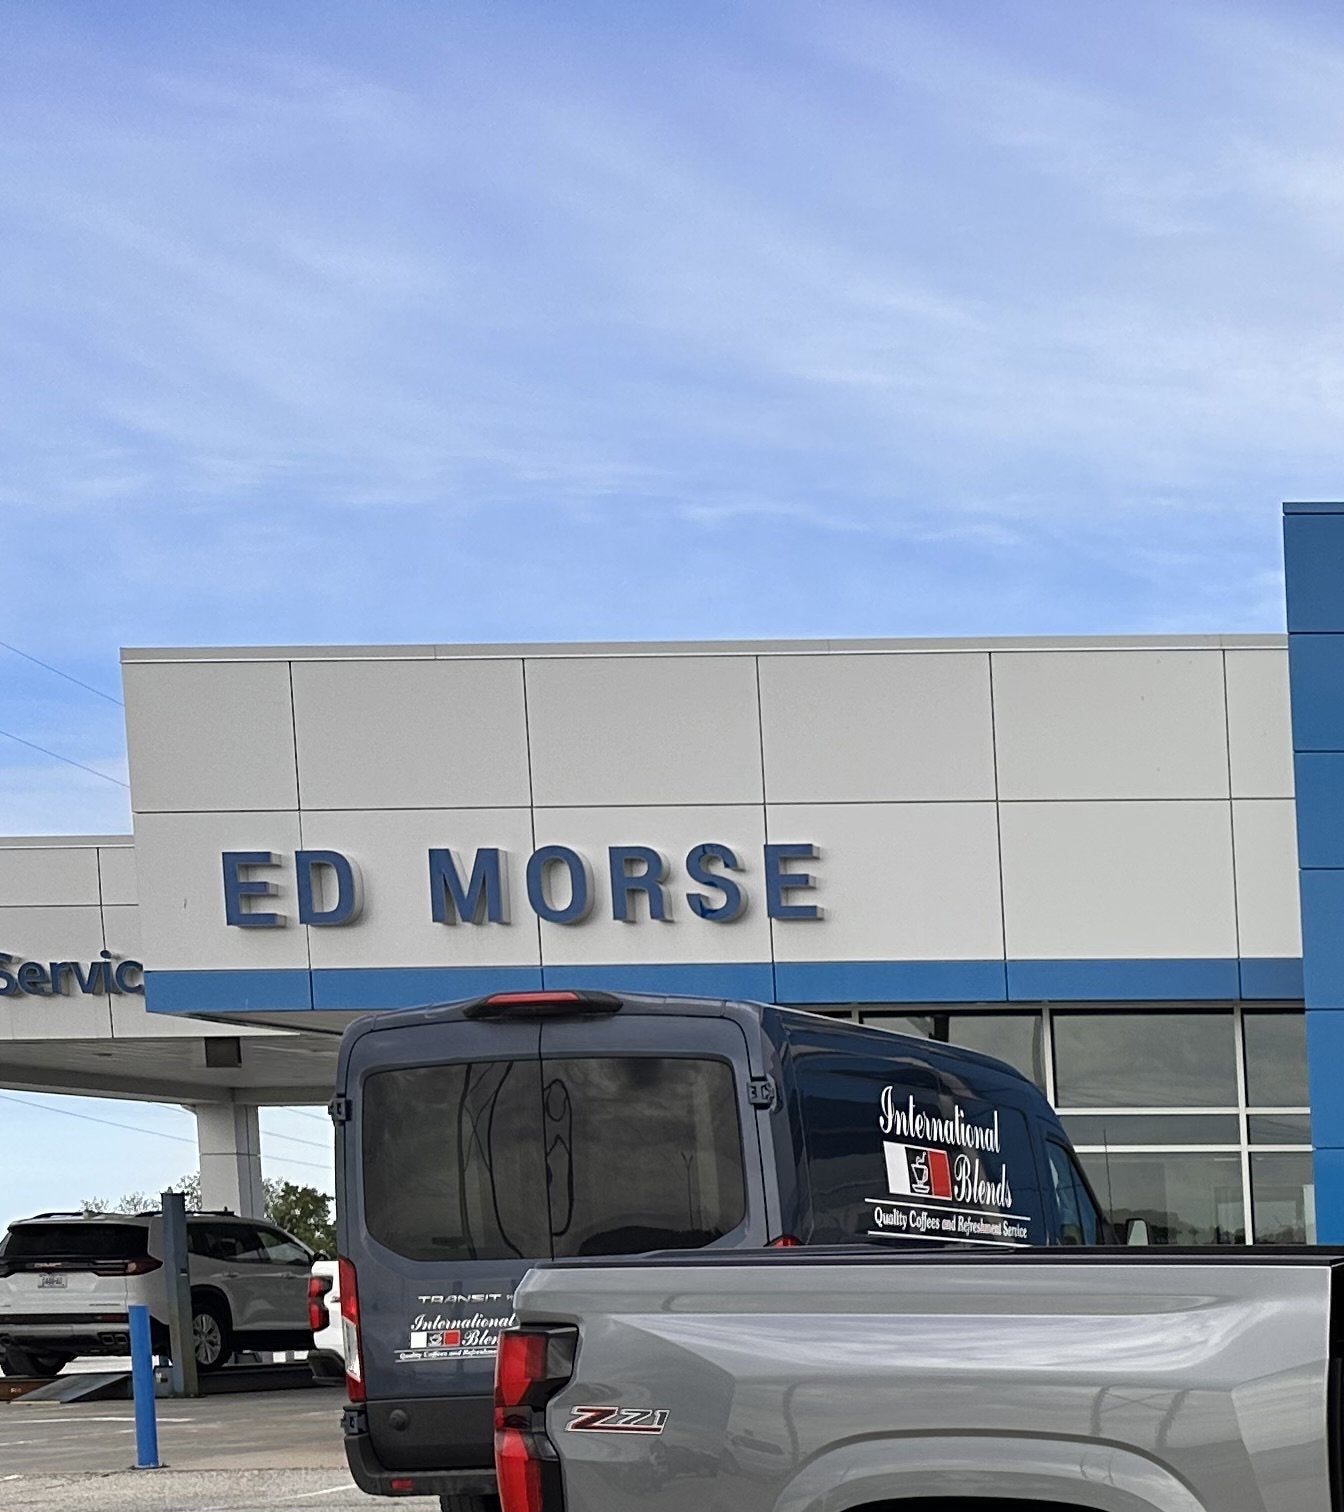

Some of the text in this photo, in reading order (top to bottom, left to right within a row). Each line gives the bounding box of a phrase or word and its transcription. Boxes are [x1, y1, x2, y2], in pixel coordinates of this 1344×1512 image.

[221, 843, 825, 927] ED MORSE
[0, 949, 144, 997] Servic
[879, 1086, 1000, 1153] International
[953, 1153, 1012, 1208] Blends
[874, 1206, 1027, 1239] Quality Coffees and Refreshment Service
[418, 1294, 502, 1303] TRANSIT
[411, 1313, 516, 1330] International
[462, 1329, 499, 1346] Blen
[564, 1405, 670, 1435] Z71
